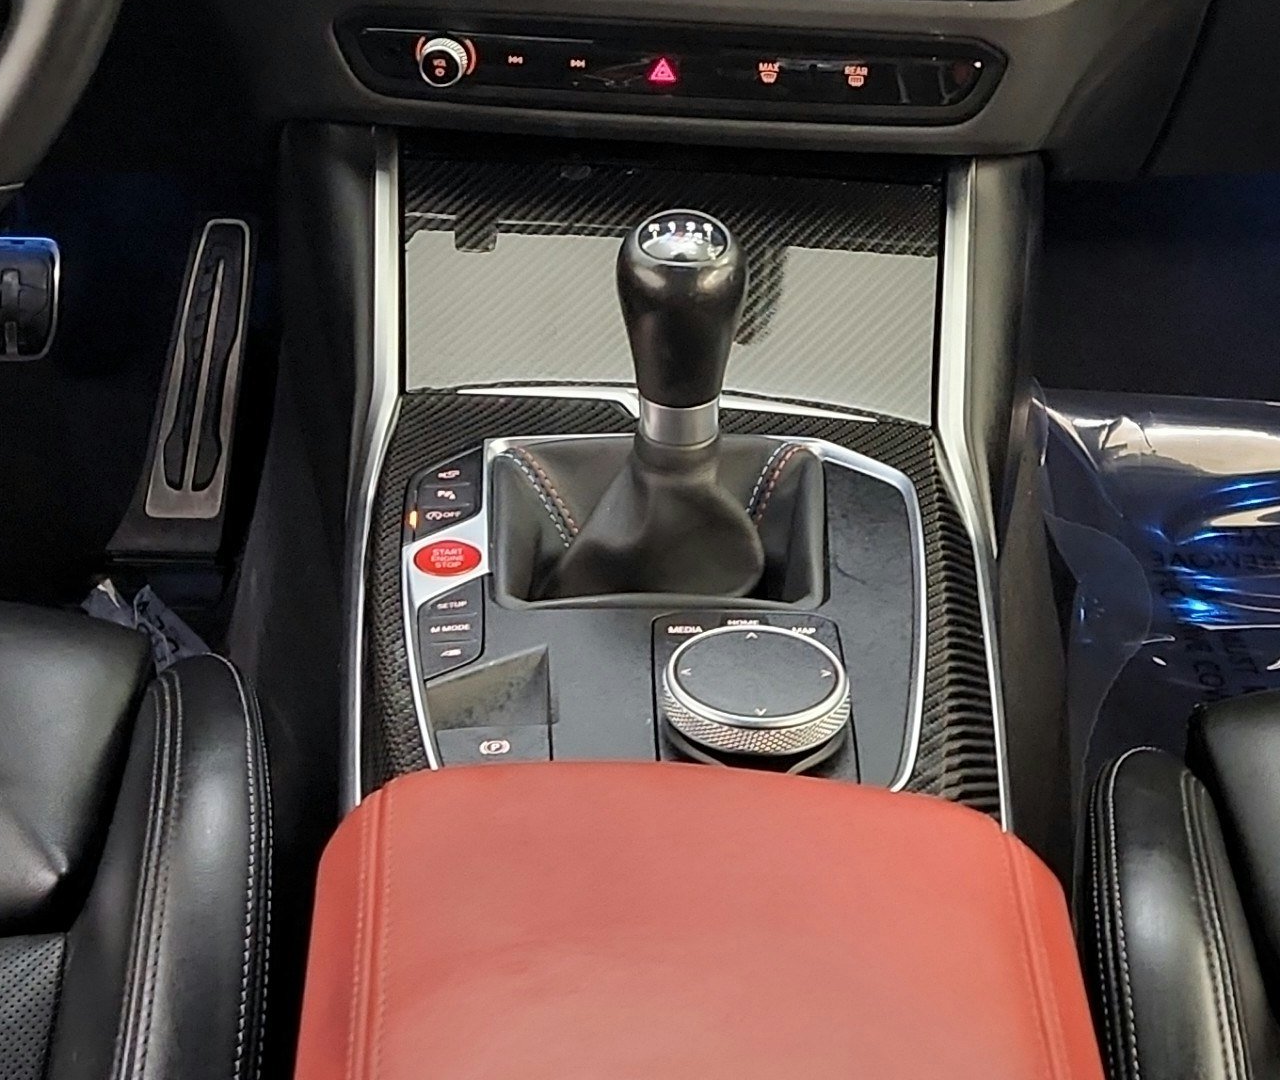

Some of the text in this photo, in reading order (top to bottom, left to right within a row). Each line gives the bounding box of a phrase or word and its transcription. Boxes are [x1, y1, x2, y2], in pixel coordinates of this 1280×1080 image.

[759, 62, 780, 72] MAX
[844, 65, 868, 76] REAR
[435, 561, 462, 569] STOP
[436, 600, 468, 610] SETUP
[441, 623, 470, 632] MODE
[667, 625, 703, 634] MEDIA
